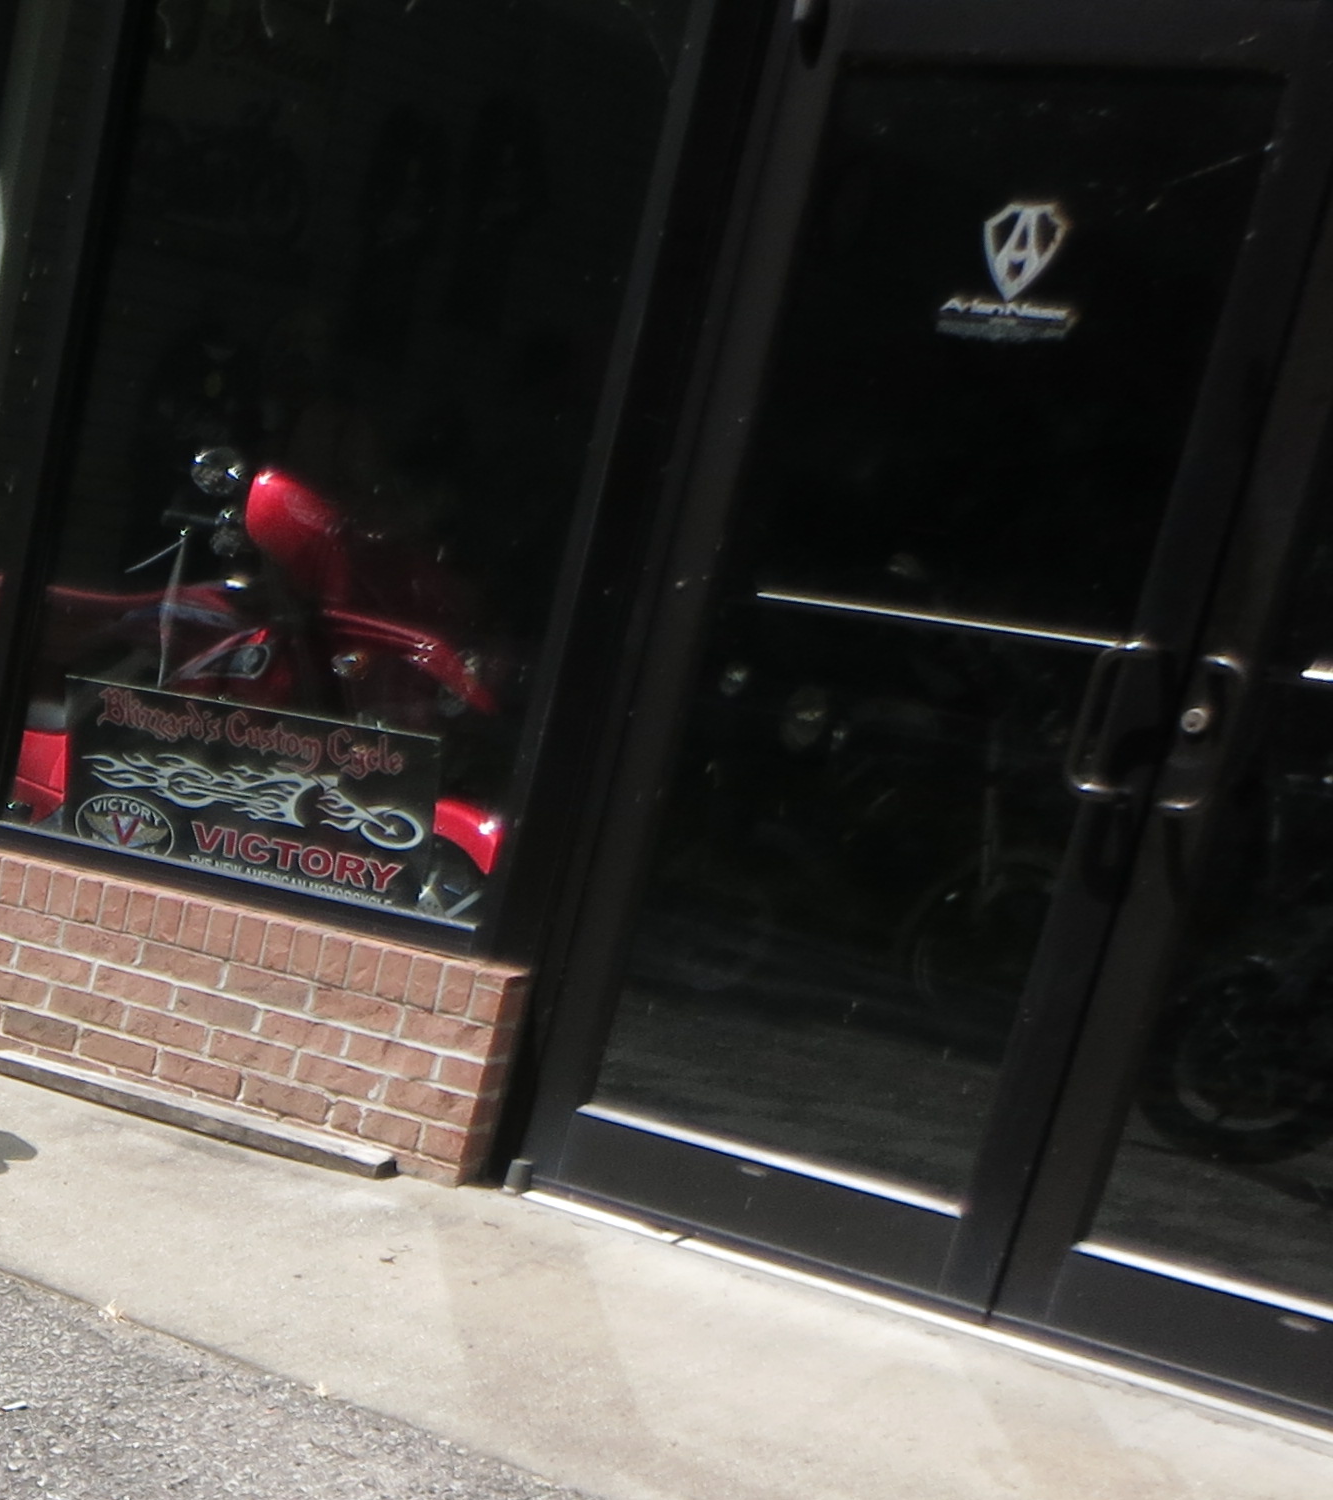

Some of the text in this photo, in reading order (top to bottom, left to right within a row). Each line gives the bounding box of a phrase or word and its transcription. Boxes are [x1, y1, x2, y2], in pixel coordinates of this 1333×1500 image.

[225, 710, 321, 774] Custom
[327, 727, 404, 779] Cycle
[92, 798, 161, 826] VICTORY
[191, 821, 403, 892] VICTORY
